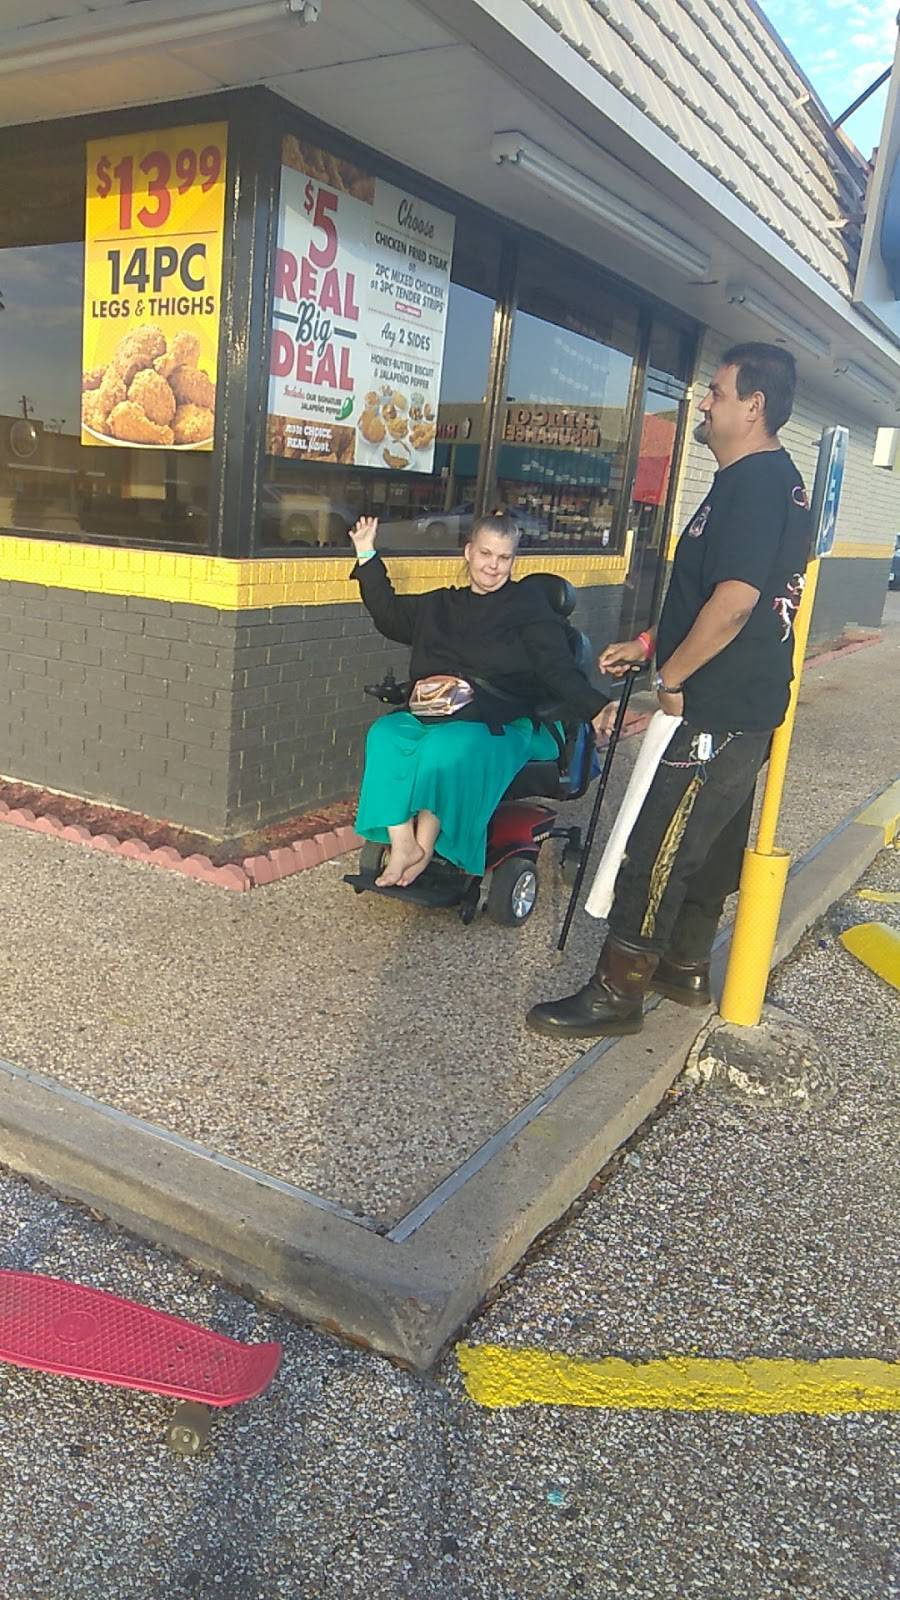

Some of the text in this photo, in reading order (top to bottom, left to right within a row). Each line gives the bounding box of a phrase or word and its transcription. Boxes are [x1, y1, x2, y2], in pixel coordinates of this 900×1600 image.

[304, 180, 339, 269] $5
[397, 199, 434, 239] Choose
[107, 243, 207, 295] 14PC
[375, 231, 449, 272] CHICKEN FRIED STEAK
[273, 248, 359, 321] REAL
[375, 263, 444, 299] 2PC MIXED CHICKEN
[380, 280, 394, 295] 3PC
[395, 286, 421, 305] TENDER
[422, 295, 445, 313] STRIPS
[92, 295, 215, 318] LEGS & THIGHS
[295, 301, 332, 357] Big
[380, 322, 431, 351] Any 2 SIDES
[270, 328, 355, 391] DEAL
[414, 365, 434, 377] BISCUIT
[410, 376, 430, 389] PEPPER
[287, 437, 308, 449] REAL
